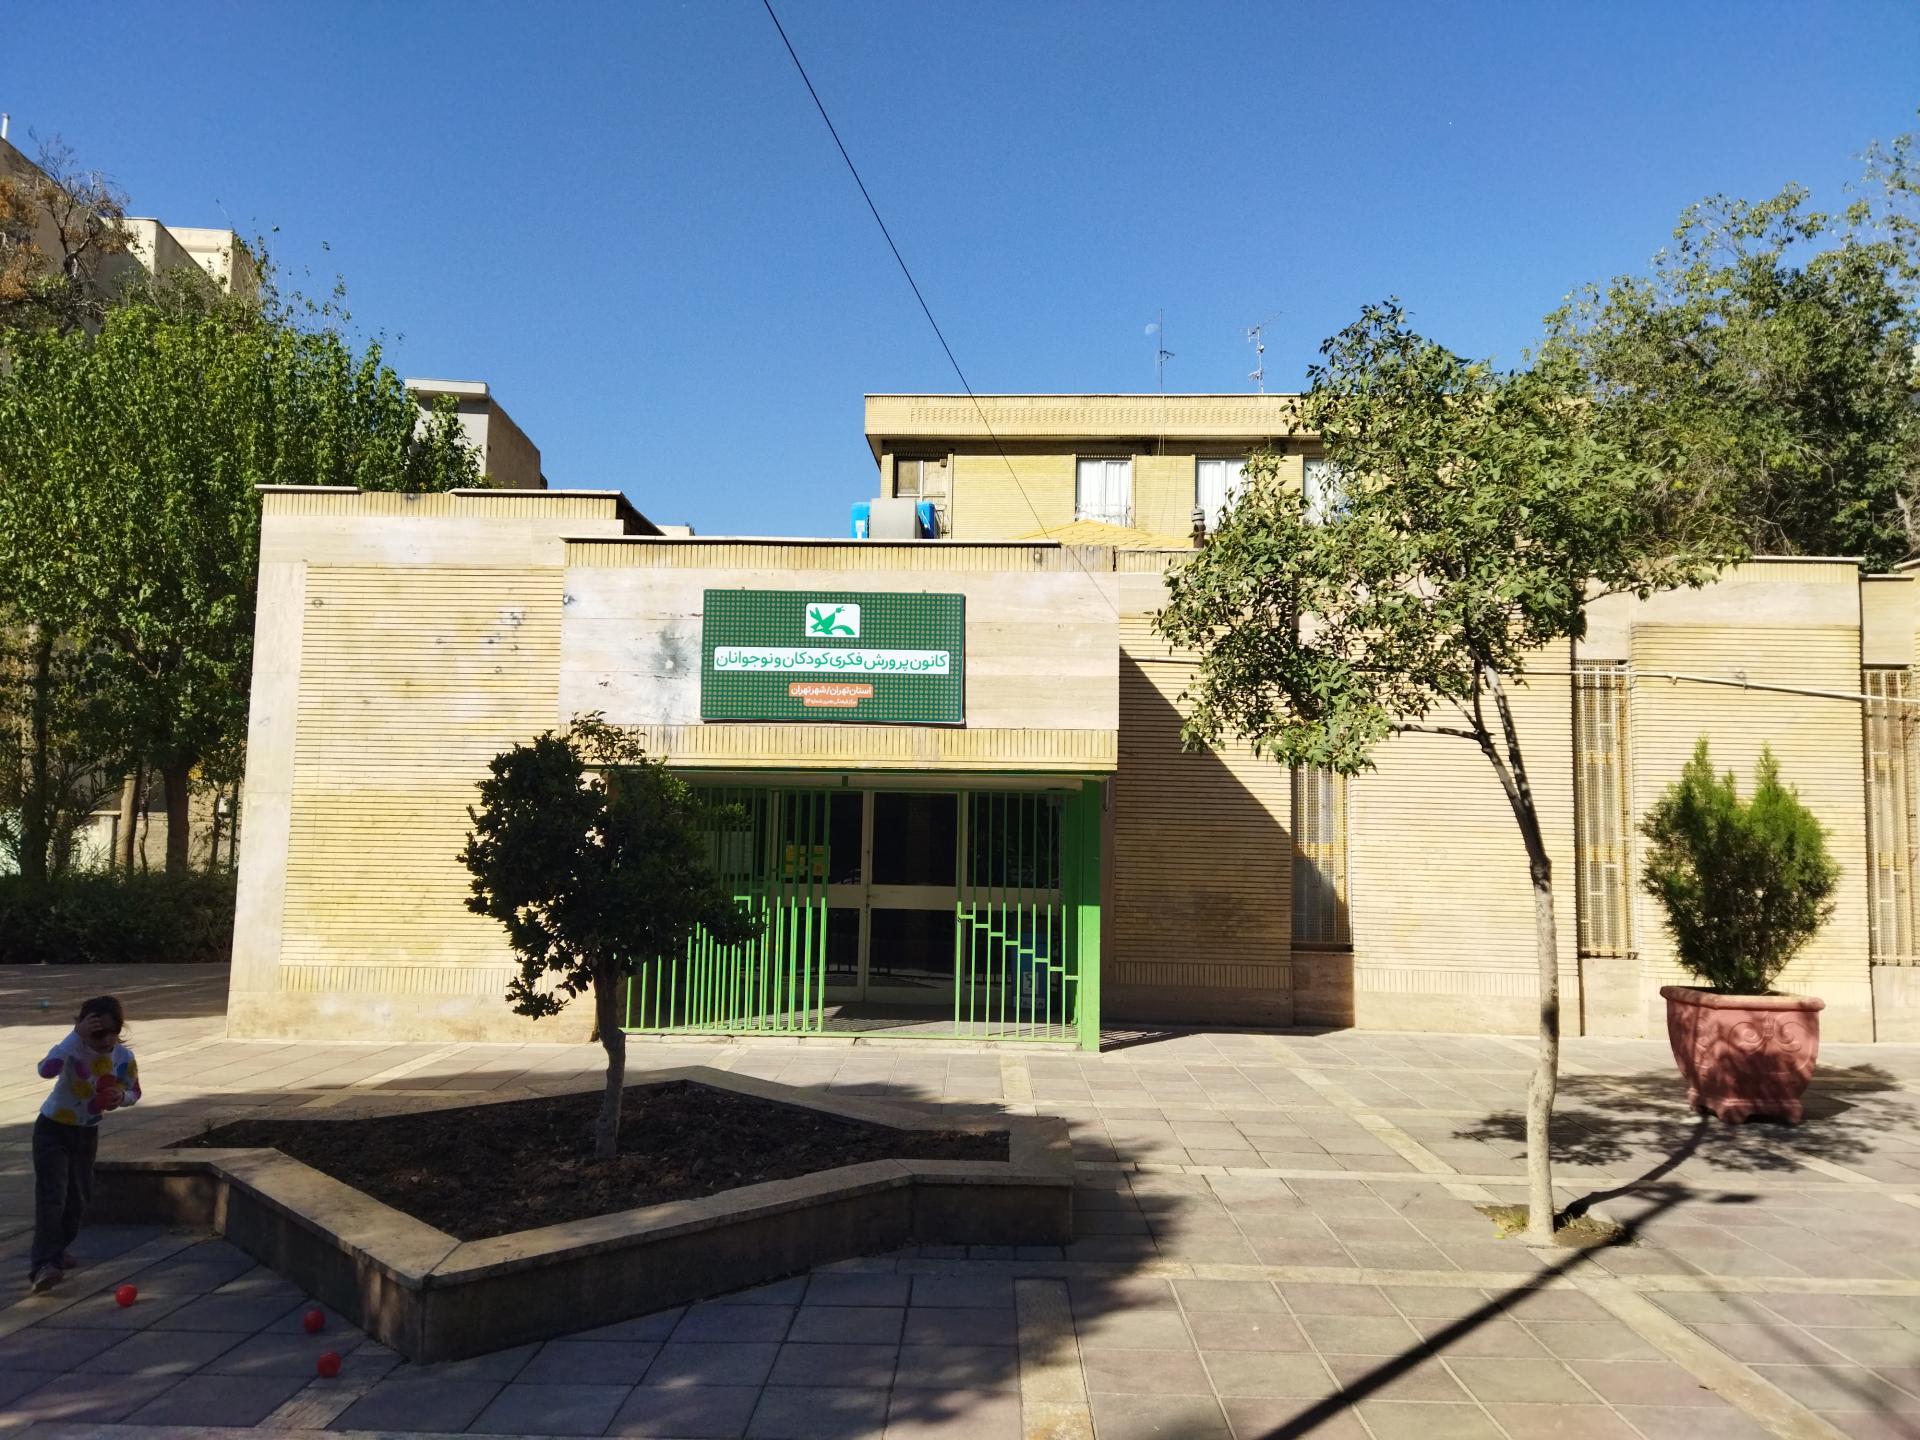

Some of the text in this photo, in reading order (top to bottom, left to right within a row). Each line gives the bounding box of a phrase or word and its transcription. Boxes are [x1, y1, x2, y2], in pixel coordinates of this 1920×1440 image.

[782, 651, 831, 669] کودکان
[829, 652, 863, 669] فکری
[864, 653, 909, 672] پرورش
[910, 654, 948, 671] کانون
[790, 684, 812, 695] تهران
[849, 685, 872, 696] استان
